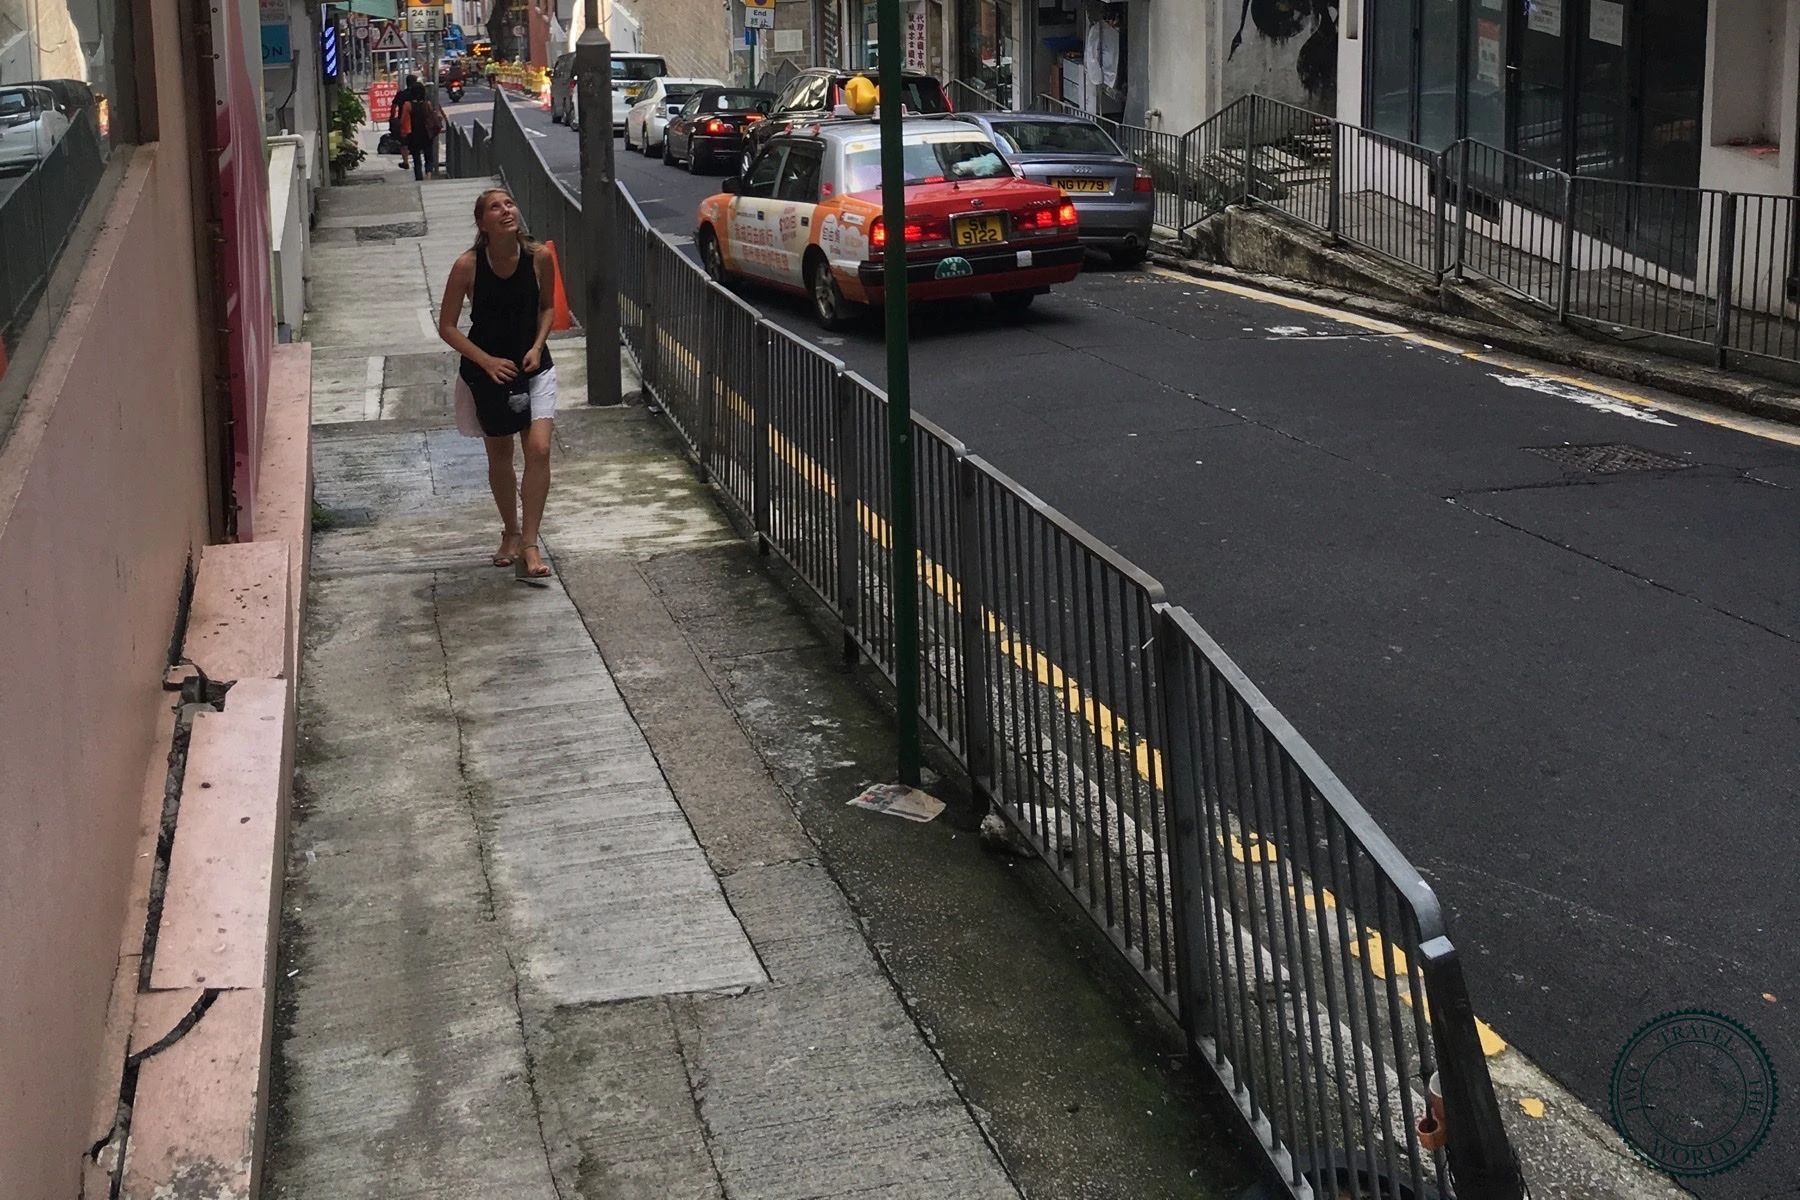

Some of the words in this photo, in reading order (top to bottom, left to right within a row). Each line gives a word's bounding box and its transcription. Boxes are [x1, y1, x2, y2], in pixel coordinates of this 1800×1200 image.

[414, 18, 438, 29] 全日
[374, 89, 398, 97] SLOW
[1057, 178, 1074, 190] NG
[1077, 178, 1105, 191] 1779
[969, 218, 988, 230] SW
[963, 229, 998, 244] 9122
